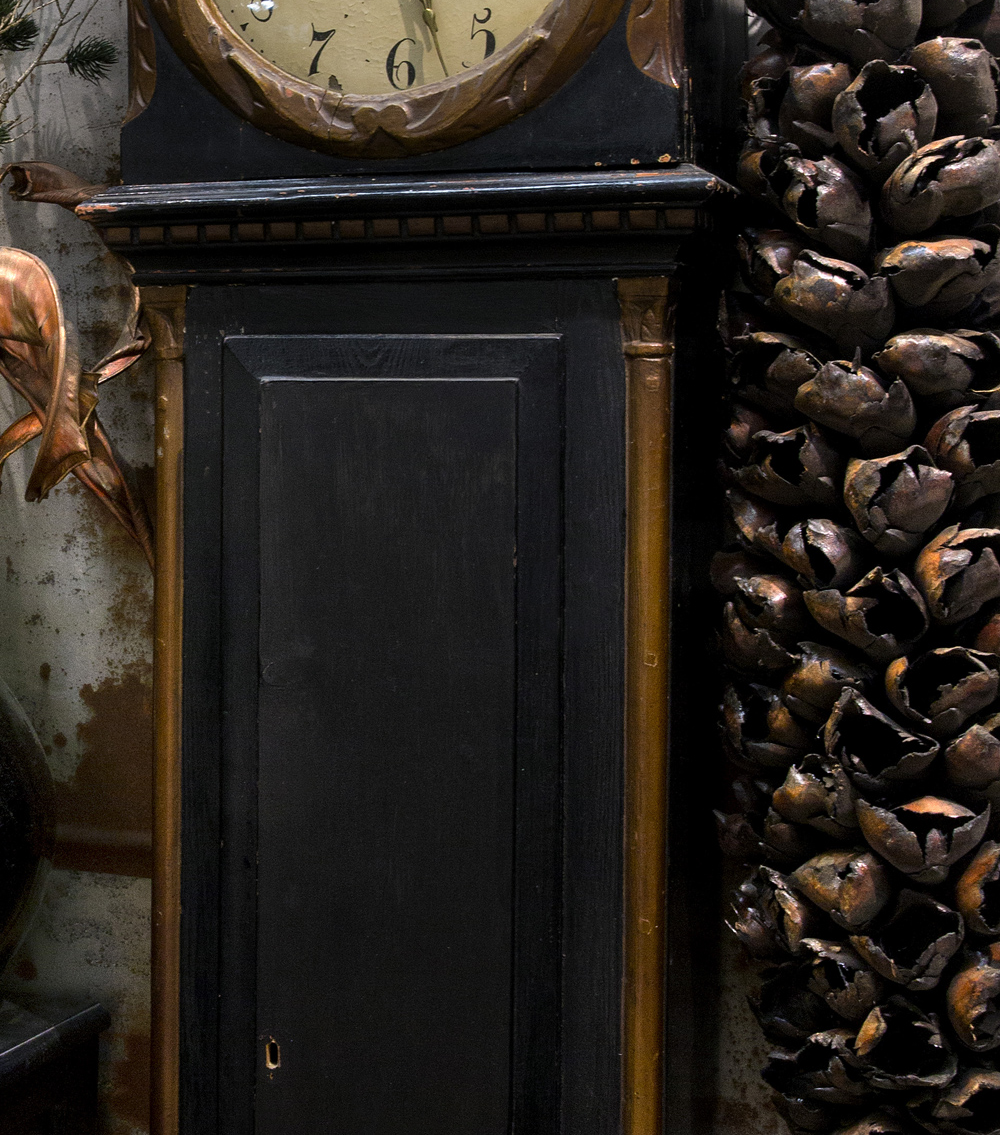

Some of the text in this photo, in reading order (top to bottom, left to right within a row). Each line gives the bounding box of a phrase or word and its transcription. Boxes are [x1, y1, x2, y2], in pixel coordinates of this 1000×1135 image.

[308, 22, 336, 77] 7
[385, 37, 416, 90] 6
[461, 8, 496, 68] 5
